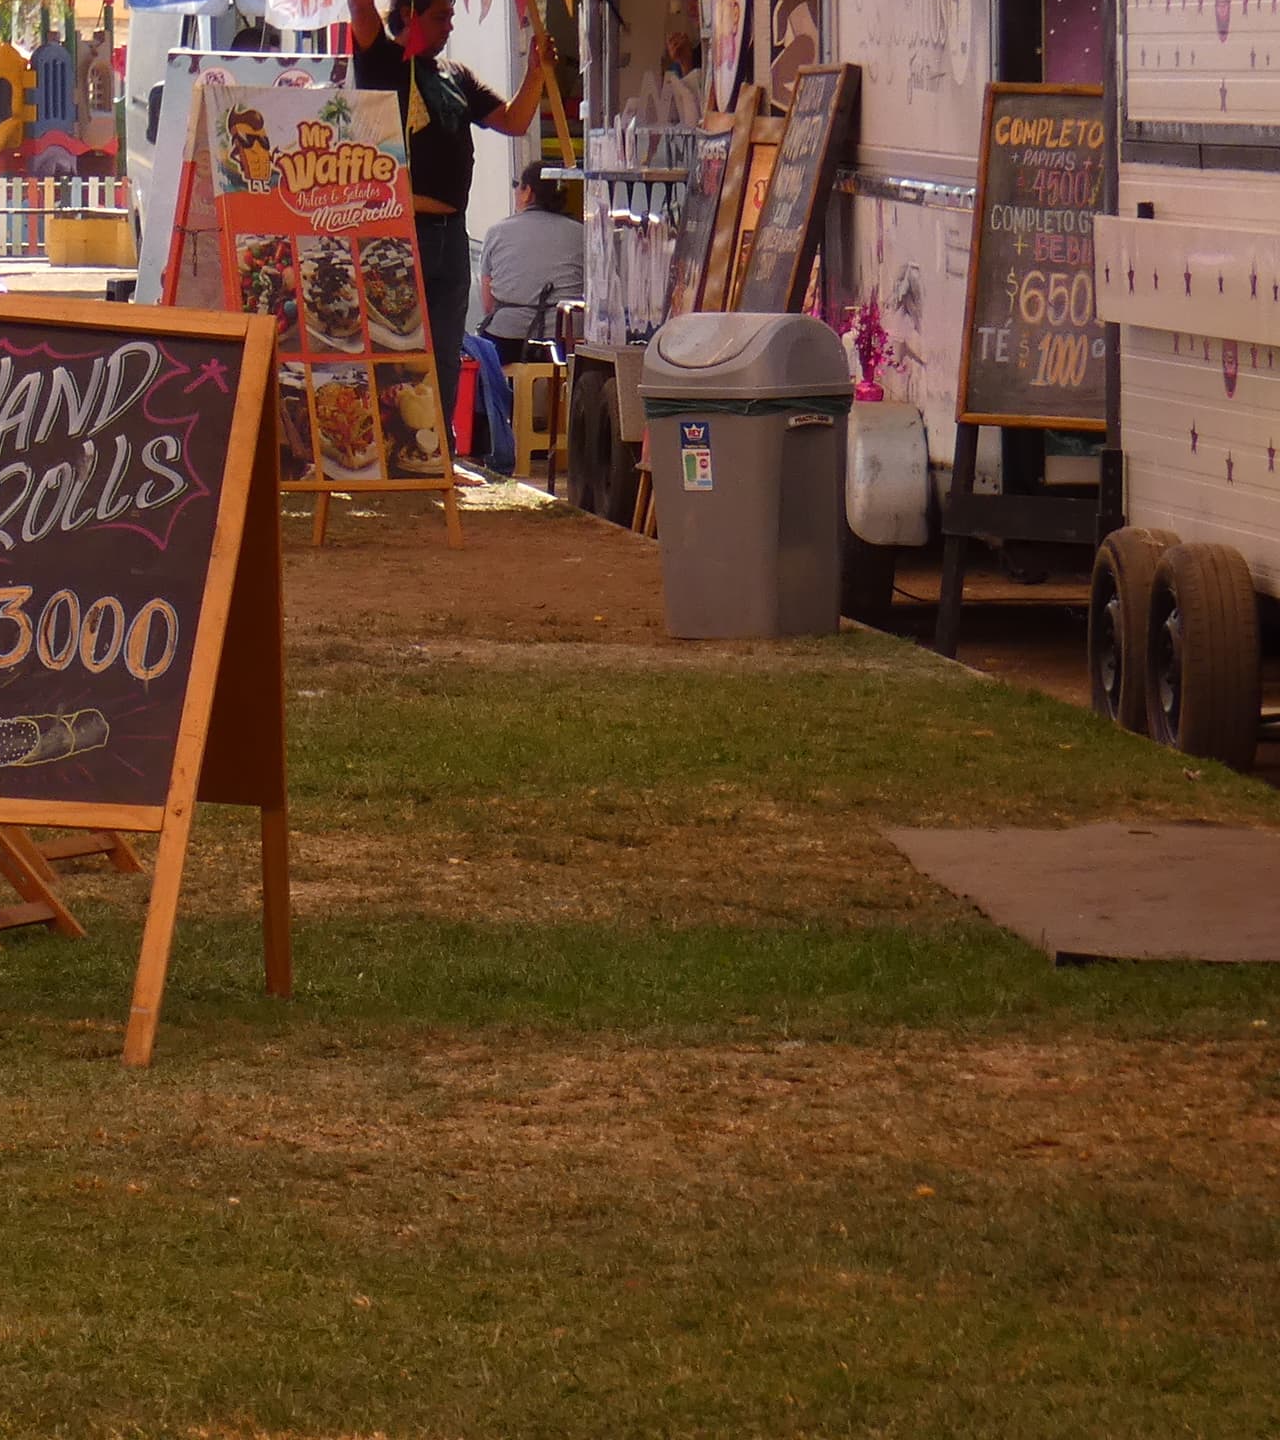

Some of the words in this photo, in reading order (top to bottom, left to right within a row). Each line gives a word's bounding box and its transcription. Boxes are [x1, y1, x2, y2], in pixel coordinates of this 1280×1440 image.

[298, 121, 333, 150] Mr
[994, 116, 1105, 149] COMPLETO
[277, 143, 396, 193] Waffle
[1023, 148, 1077, 171] PAPITAS
[991, 204, 1075, 234] COMPLETO
[1019, 270, 1105, 328] 650
[977, 318, 1012, 362] TÉ
[1029, 331, 1089, 387] 1000
